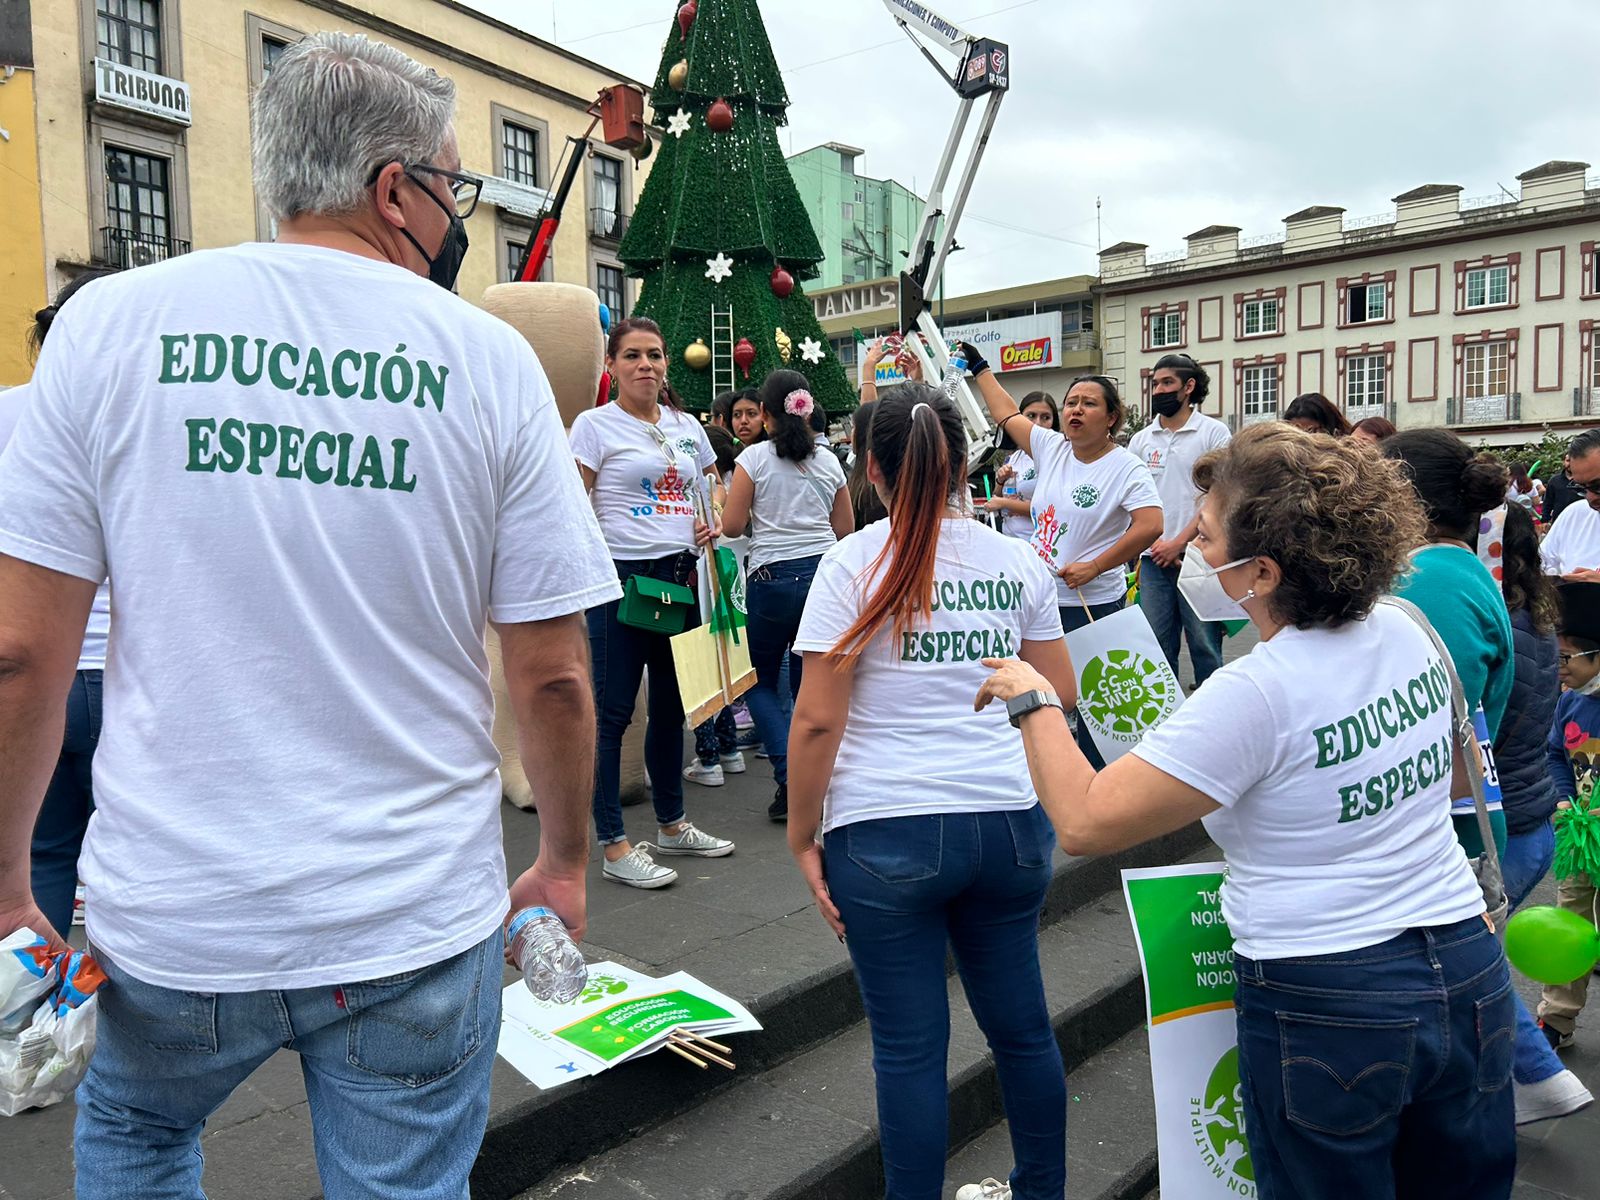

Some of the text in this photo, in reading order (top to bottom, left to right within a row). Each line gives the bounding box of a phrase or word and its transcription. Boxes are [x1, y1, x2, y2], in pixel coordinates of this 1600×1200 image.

[98, 60, 187, 112] TRIBUNA
[974, 331, 1001, 343] Golfo
[158, 334, 449, 413] EDUCACIÓN
[185, 417, 417, 493] ESPECIAL
[630, 505, 653, 516] YO
[656, 504, 671, 514] SI
[912, 571, 1025, 611] UCACIÓN
[901, 627, 1014, 662] ESPECIAL
[1097, 674, 1123, 700] 55
[1104, 684, 1144, 710] CAM
[1158, 661, 1177, 704] CENTRO
[1313, 657, 1450, 769] EDUCACIÓN
[1337, 729, 1453, 823] ESPECIA
[1190, 910, 1226, 928] CIÓN
[1191, 949, 1236, 967] DARIA
[1196, 969, 1238, 988] ACIÓN
[1190, 1096, 1225, 1179] MULTIPLE
